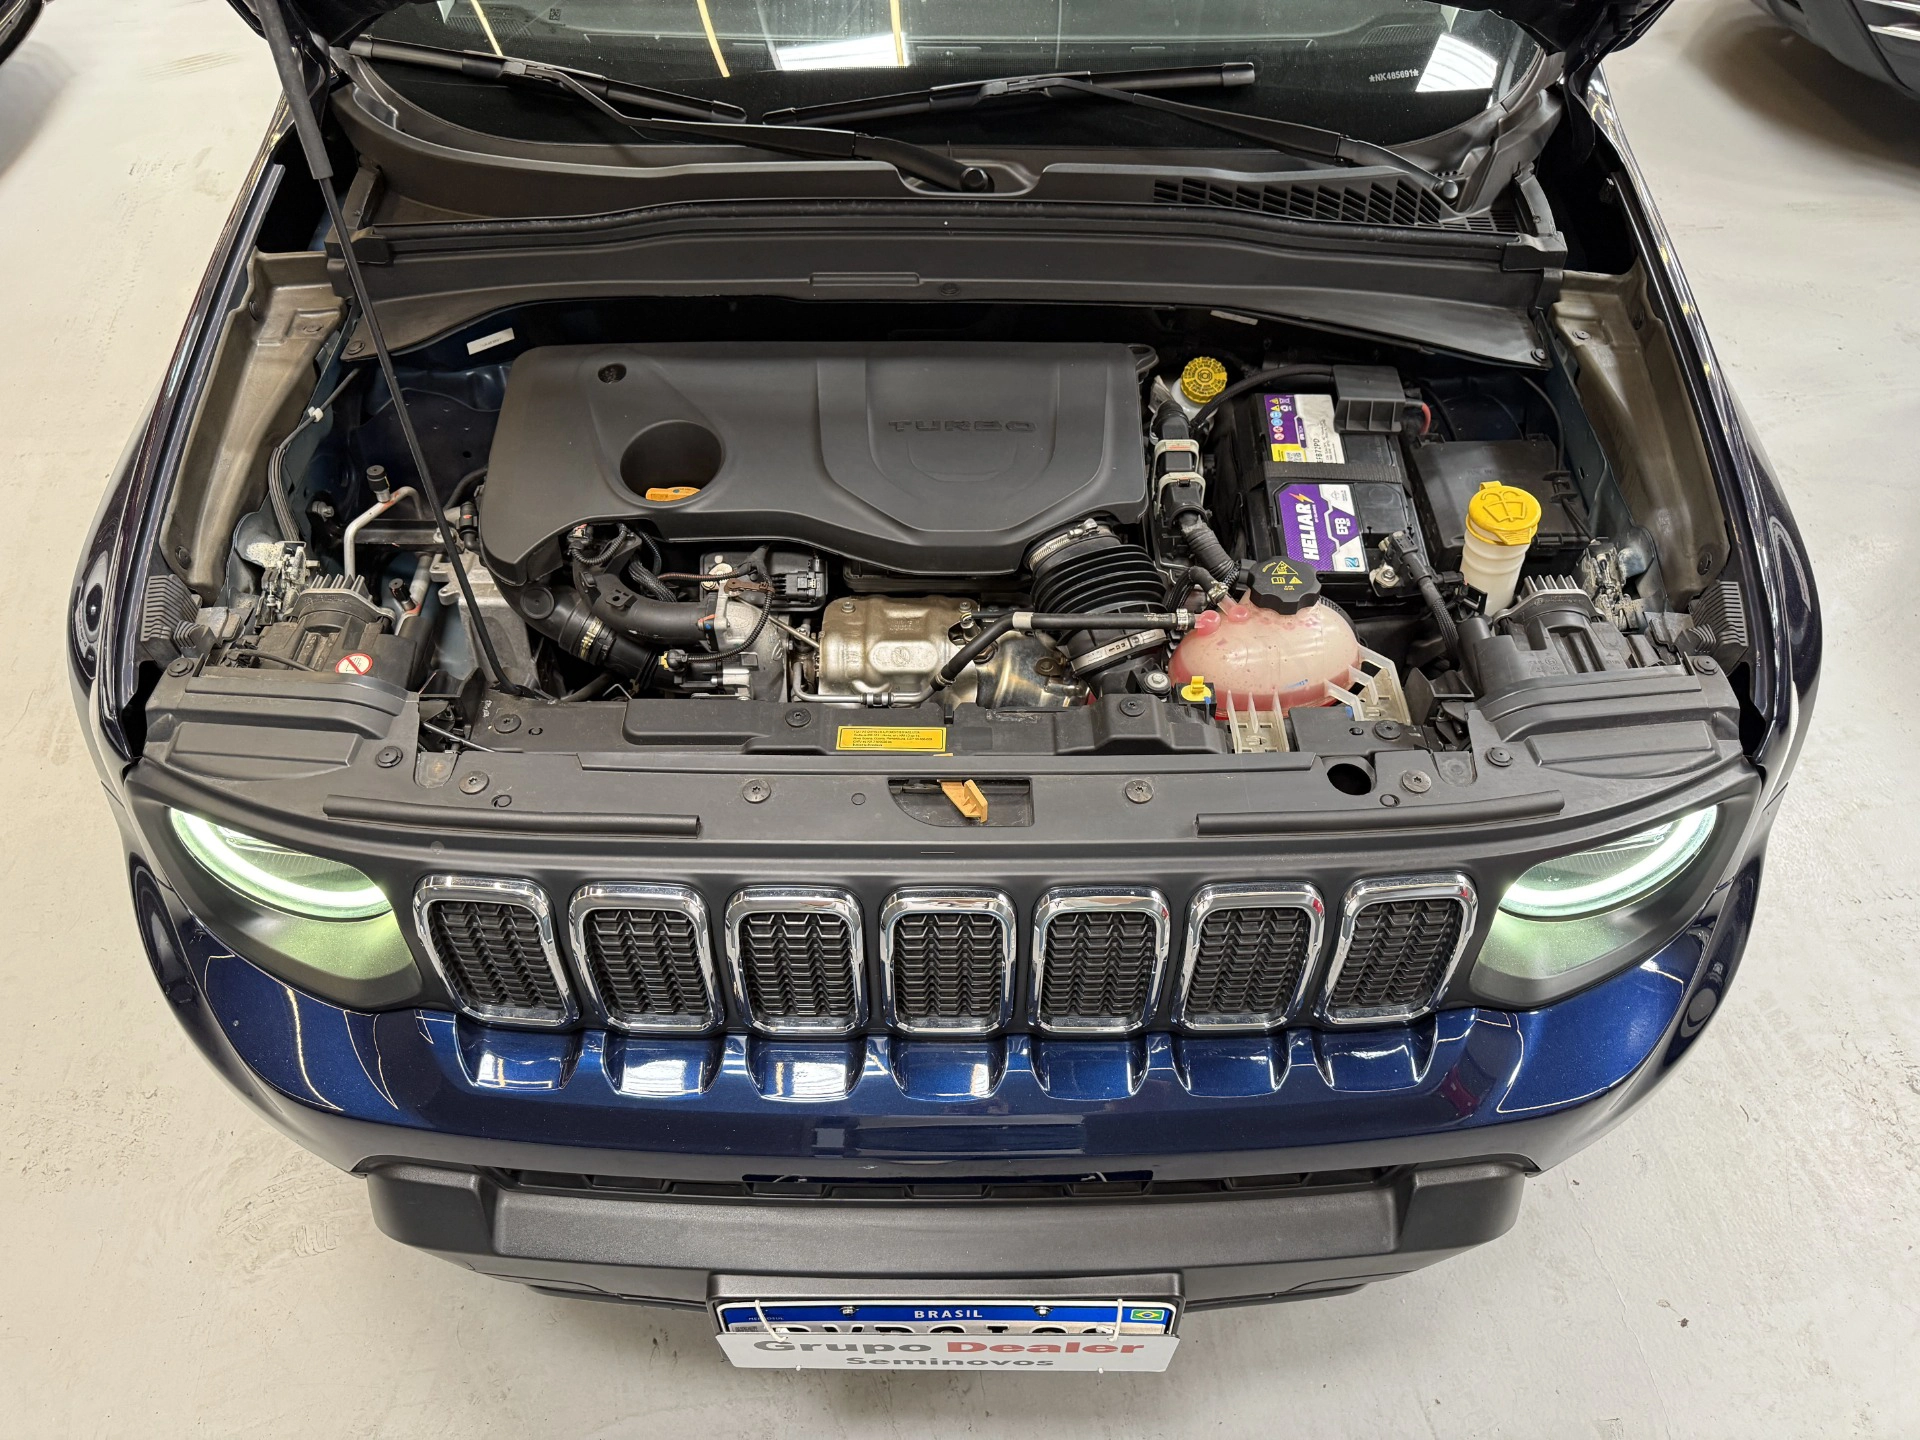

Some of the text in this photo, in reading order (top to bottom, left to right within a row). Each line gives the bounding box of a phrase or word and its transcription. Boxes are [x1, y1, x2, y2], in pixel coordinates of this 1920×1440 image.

[888, 420, 1037, 432] TURBO
[1295, 503, 1320, 561] HELIAR
[1334, 518, 1349, 535] EFB
[914, 1310, 983, 1319] BRASIL
[753, 1340, 1145, 1354] Grupo Dealer
[846, 1357, 1054, 1366] Seminovos
